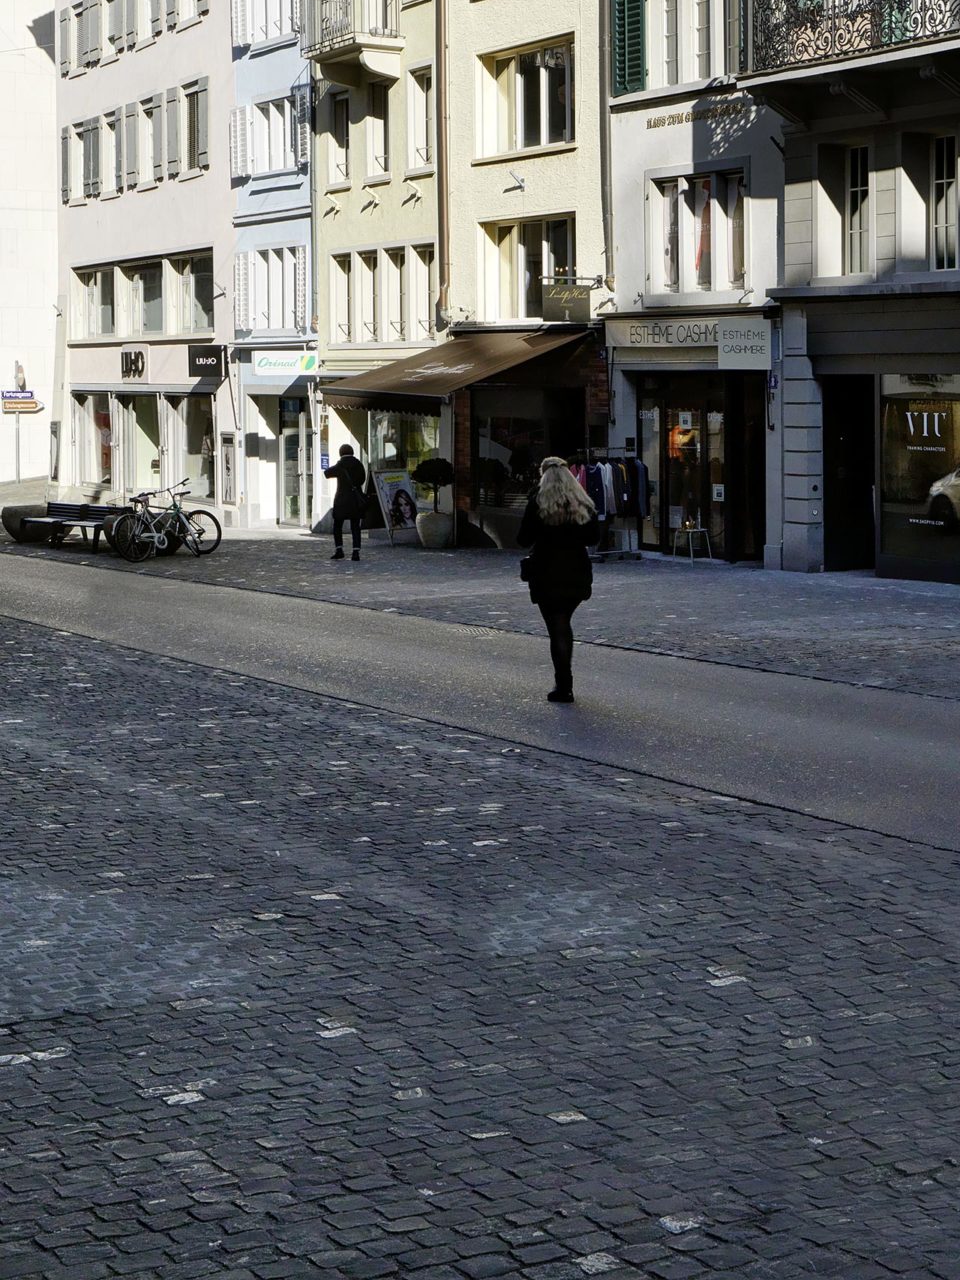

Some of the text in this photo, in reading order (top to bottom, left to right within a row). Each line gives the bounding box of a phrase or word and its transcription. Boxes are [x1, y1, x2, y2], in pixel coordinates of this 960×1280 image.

[646, 116, 667, 130] HAUS
[667, 112, 684, 126] ZUM
[722, 344, 766, 355] CASHMERE
[905, 412, 947, 437] VIU
